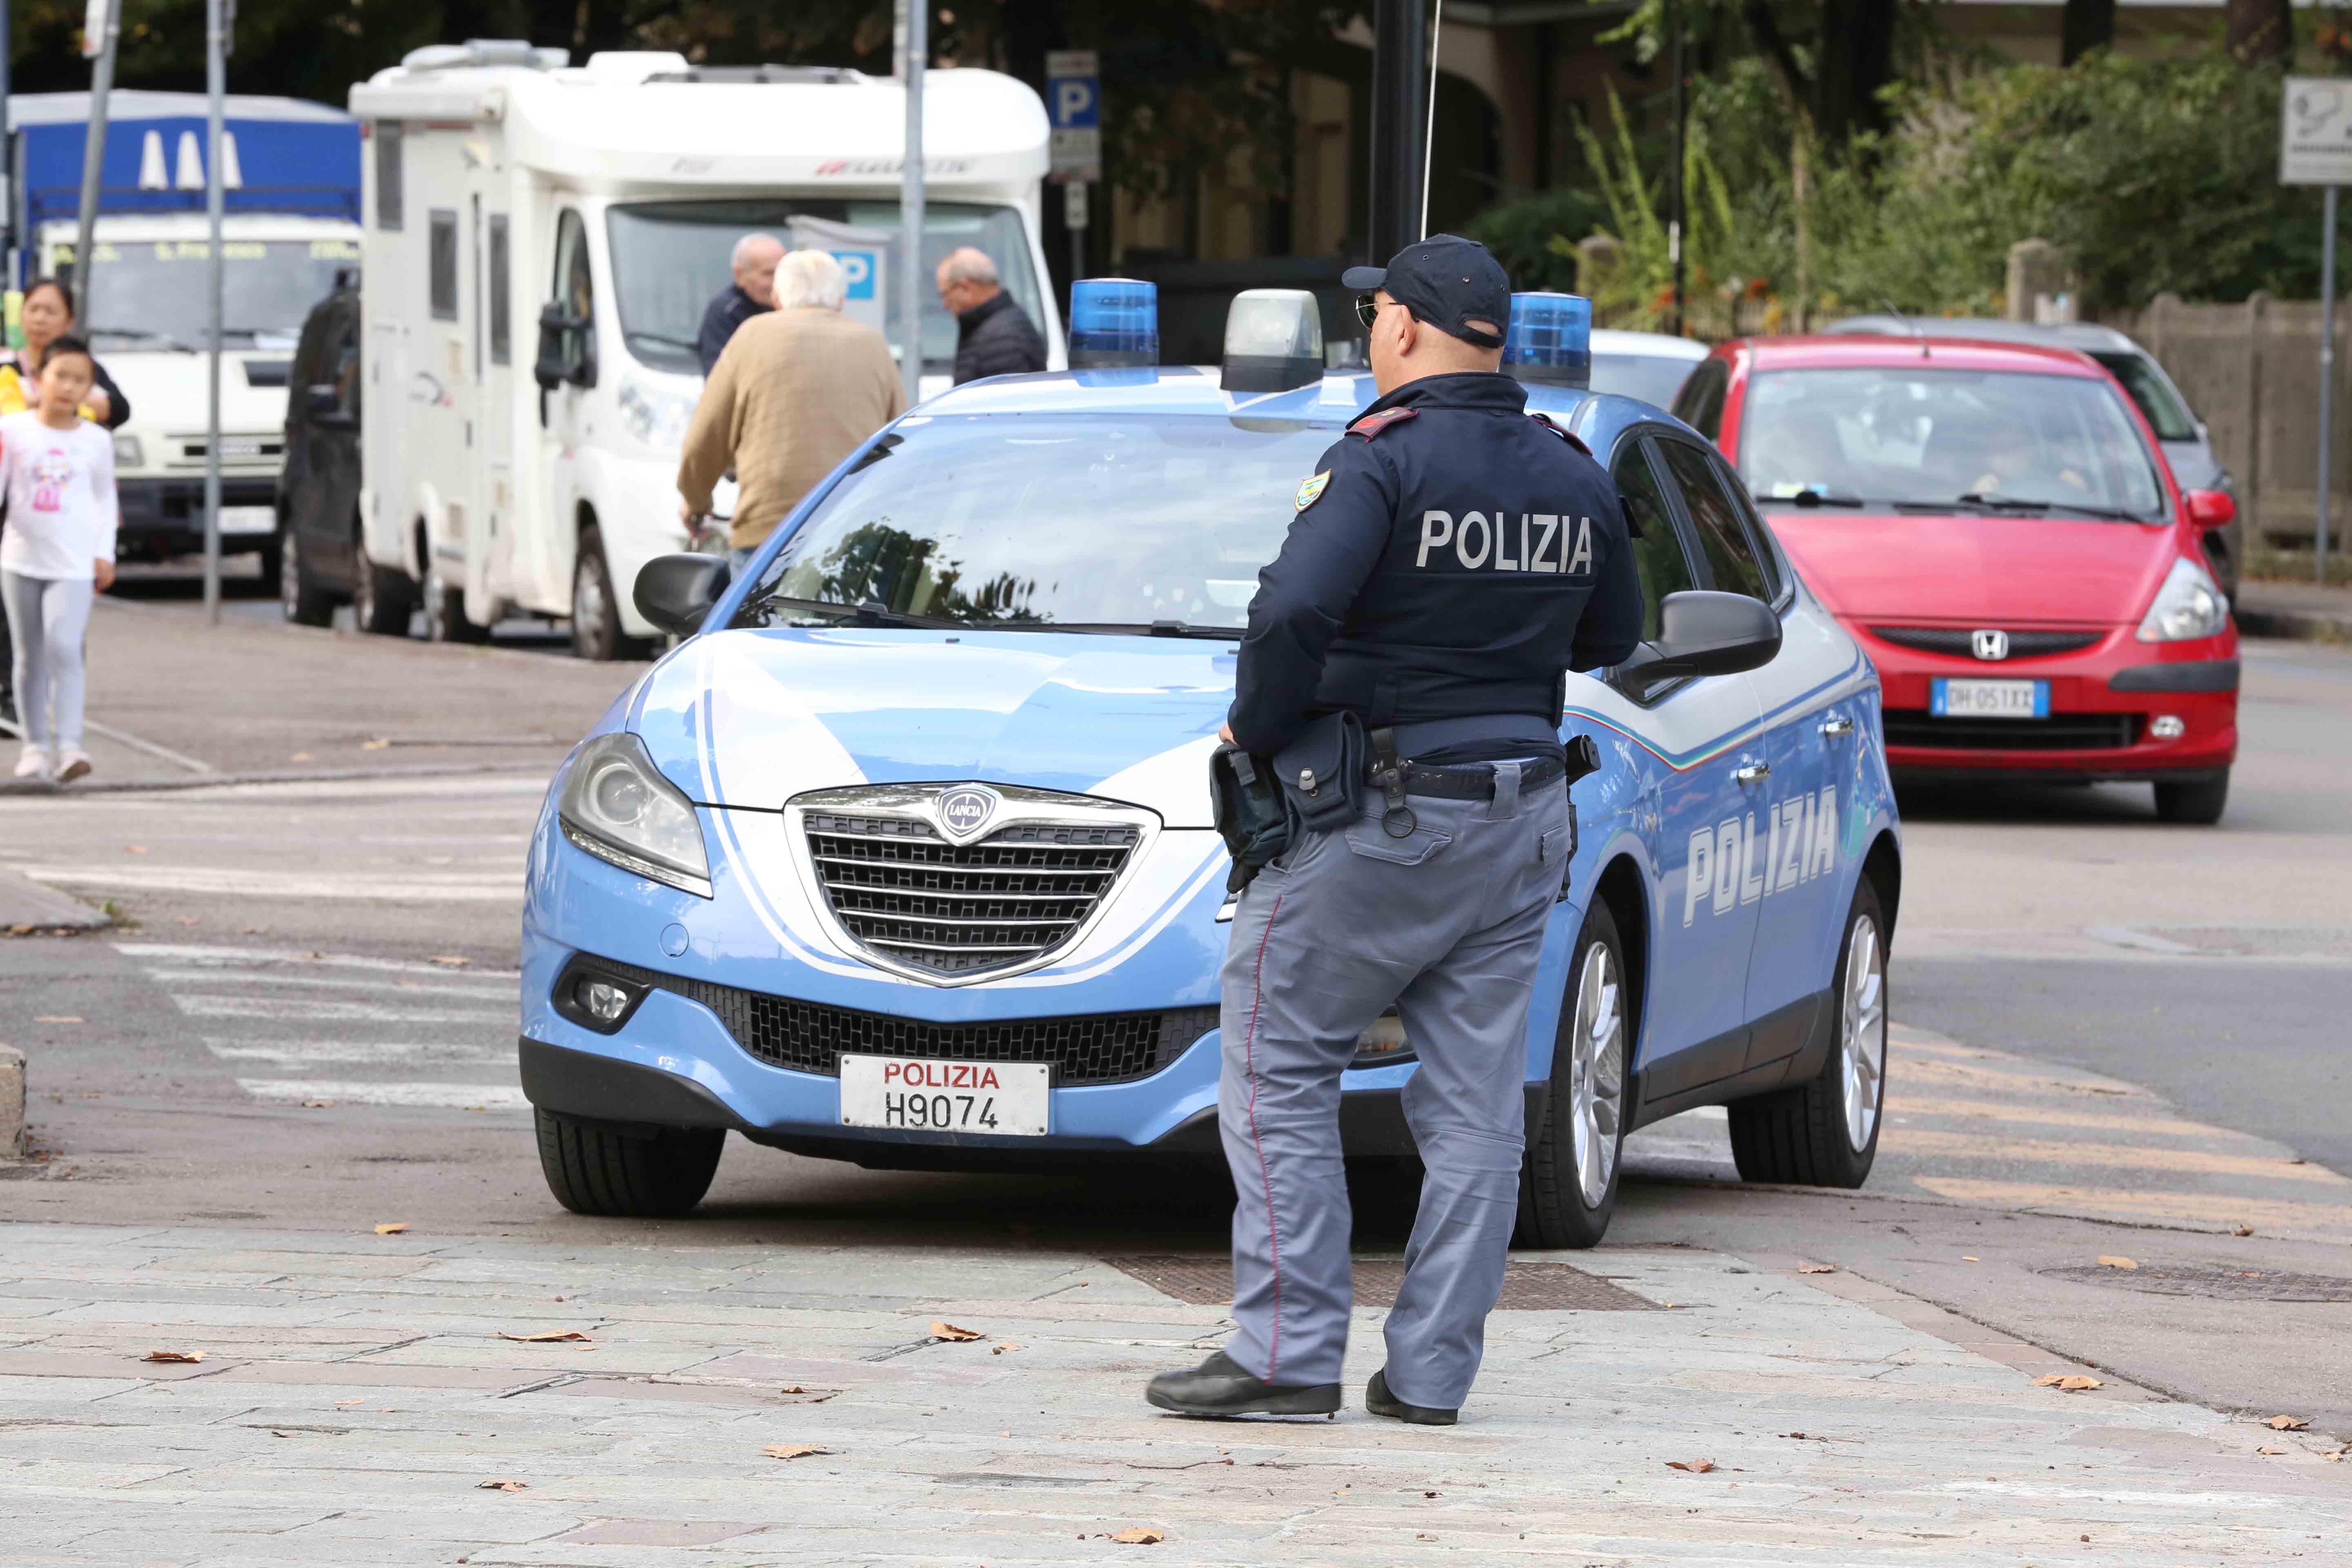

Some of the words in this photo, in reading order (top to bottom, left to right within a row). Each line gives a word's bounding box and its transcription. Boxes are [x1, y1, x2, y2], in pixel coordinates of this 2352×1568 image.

[1058, 82, 1091, 123] P
[839, 255, 869, 297] P
[1415, 510, 1592, 574] POLIZIA
[949, 804, 981, 817] LANCIA
[1683, 784, 1838, 928] POLIZIA
[884, 1061, 1000, 1089] POLIZIA
[885, 1092, 999, 1129] H9074
